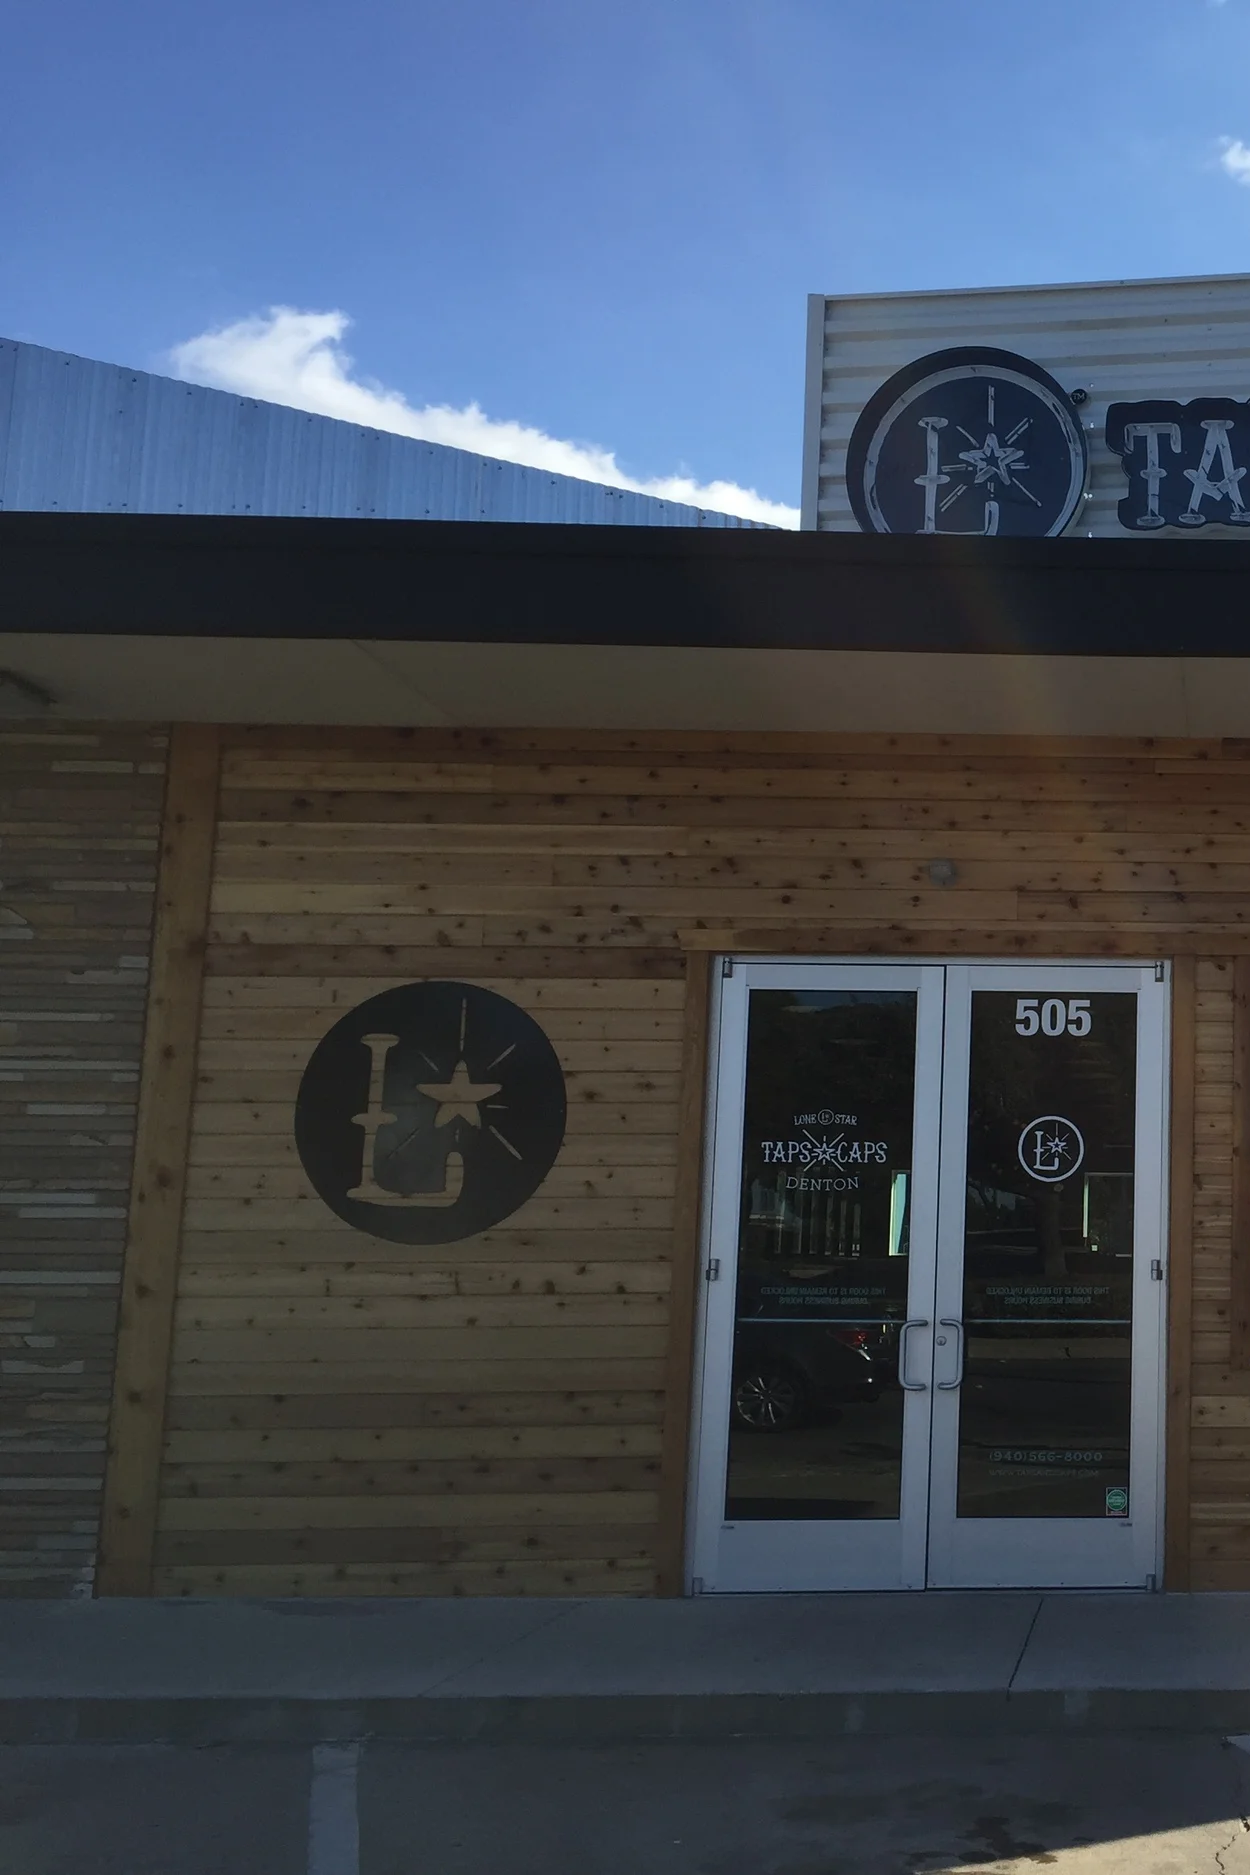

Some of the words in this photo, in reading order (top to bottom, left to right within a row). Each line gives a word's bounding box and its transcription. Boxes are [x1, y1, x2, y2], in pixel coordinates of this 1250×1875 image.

[1072, 392, 1085, 400] TM
[1014, 998, 1093, 1037] 505
[794, 1114, 817, 1126] LONE
[834, 1114, 858, 1126] STAR
[761, 1141, 812, 1163] TAPS
[836, 1141, 888, 1163] CAPS
[786, 1176, 859, 1191] DENTON
